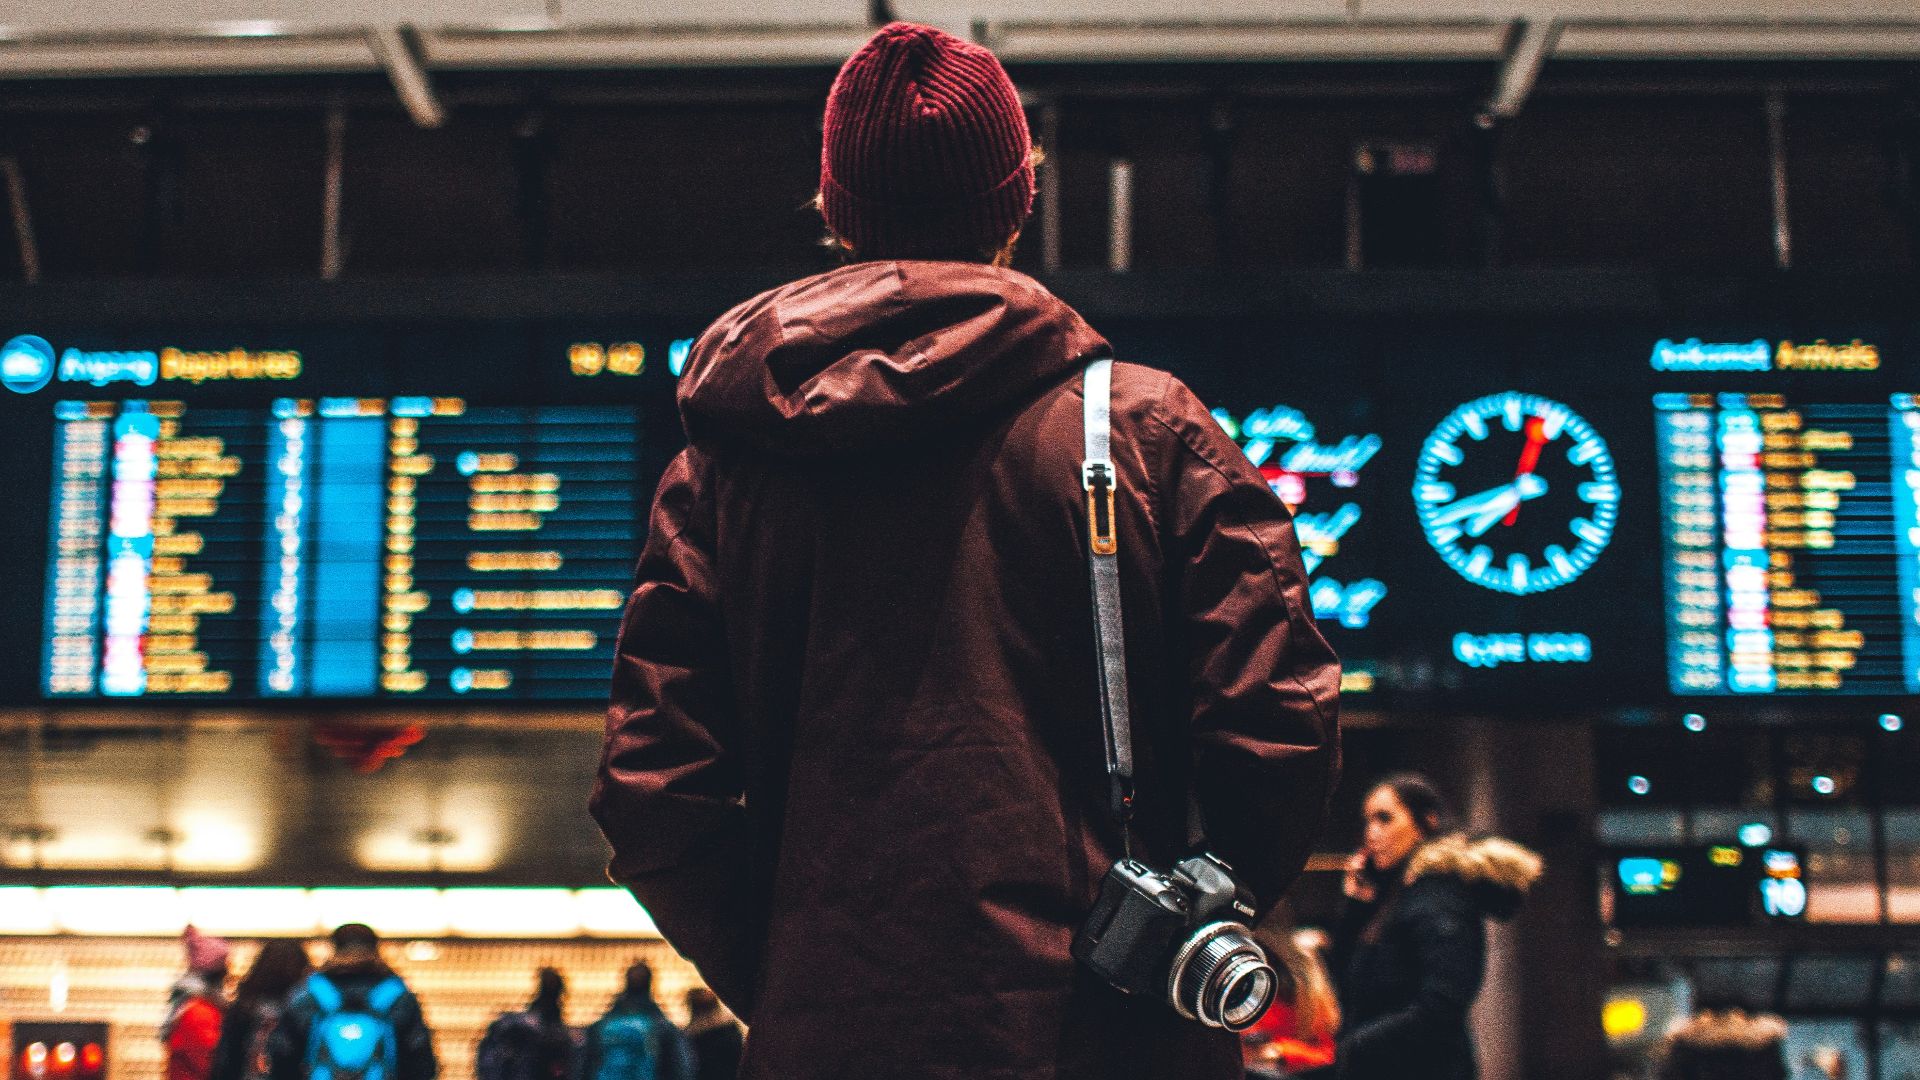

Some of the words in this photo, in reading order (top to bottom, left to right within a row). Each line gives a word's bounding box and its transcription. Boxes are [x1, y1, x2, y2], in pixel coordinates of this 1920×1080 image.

[162, 347, 301, 384] Departures
[1777, 339, 1880, 370] Arrivals
[1233, 901, 1255, 917] Canon
